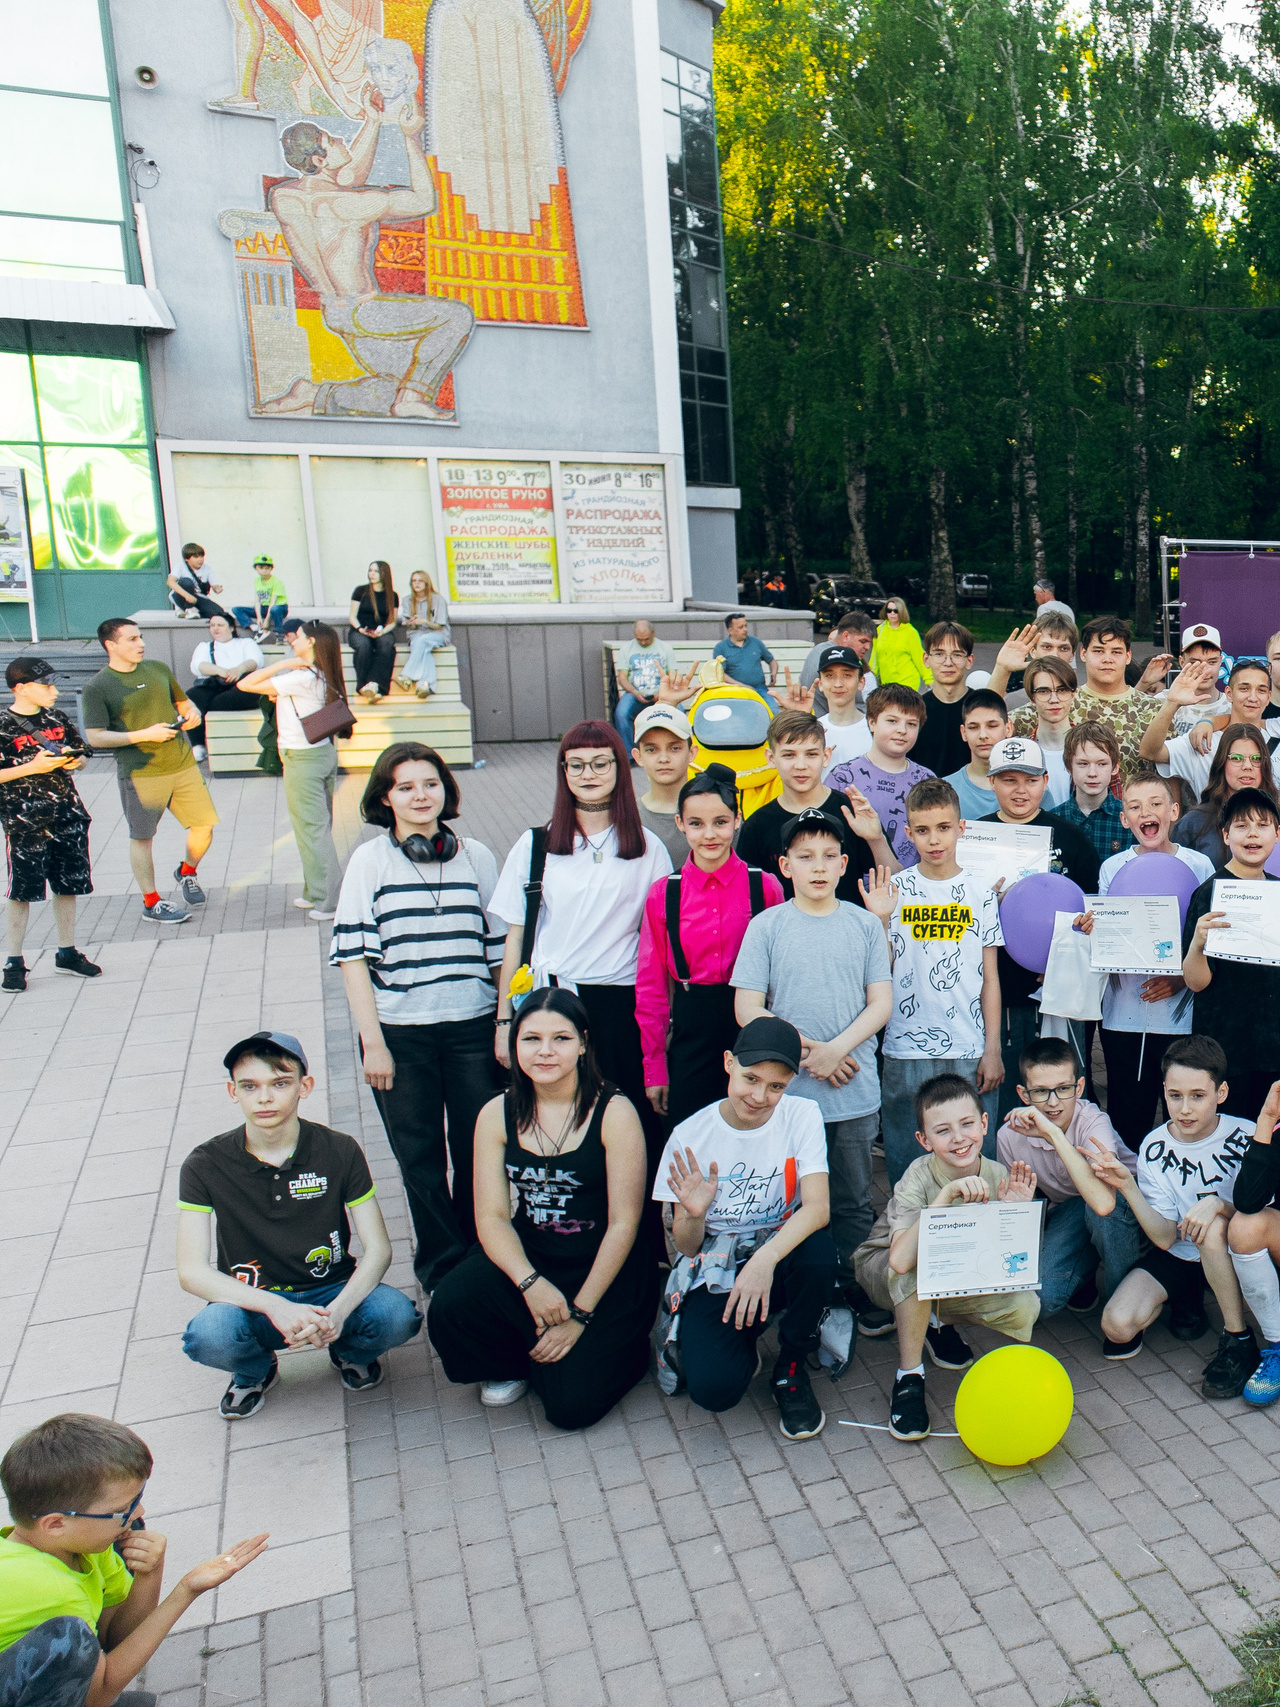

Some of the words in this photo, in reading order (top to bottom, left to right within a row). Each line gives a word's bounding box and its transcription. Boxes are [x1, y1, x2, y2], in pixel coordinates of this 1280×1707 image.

[564, 473, 586, 486] 30
[446, 487, 509, 501] ЗОЛОТОЕ
[511, 488, 548, 501] РУНО
[581, 494, 646, 506] ГРАНДИОЗНАЯ
[465, 513, 534, 525] ГРАНДИОЗНАЯ
[565, 508, 662, 522] РАСПРОДАЖА
[450, 525, 549, 537] РАСПРОДАЖА
[566, 525, 663, 535] ТРИКОТАЖНЫХ
[453, 540, 511, 550] ЖЕНСКИЕ
[514, 540, 551, 550] ШУБЫ
[586, 537, 646, 549] ИЗДЕЛИЙ
[455, 551, 523, 562] ДУБЛЕНКИ
[572, 560, 586, 569] ИЗ
[588, 555, 660, 568] НАТУРАЛЬНОГО
[590, 568, 647, 584] ХЛОПКА
[960, 833, 998, 842] ертификат
[1220, 892, 1263, 901] Сертификат
[902, 905, 971, 924] НАВЕДЁМ
[1092, 909, 1130, 917] Сертификат
[913, 924, 964, 940] СУЕТУ?
[1145, 1126, 1253, 1188] OFFLINE
[298, 1171, 318, 1181] REAL
[505, 1163, 584, 1186] TALK
[728, 1161, 784, 1200] Start
[288, 1176, 328, 1190] CHAMPS
[525, 1203, 567, 1225] HIT
[928, 1221, 977, 1231] Сертификат
[305, 1245, 333, 1278] 3
